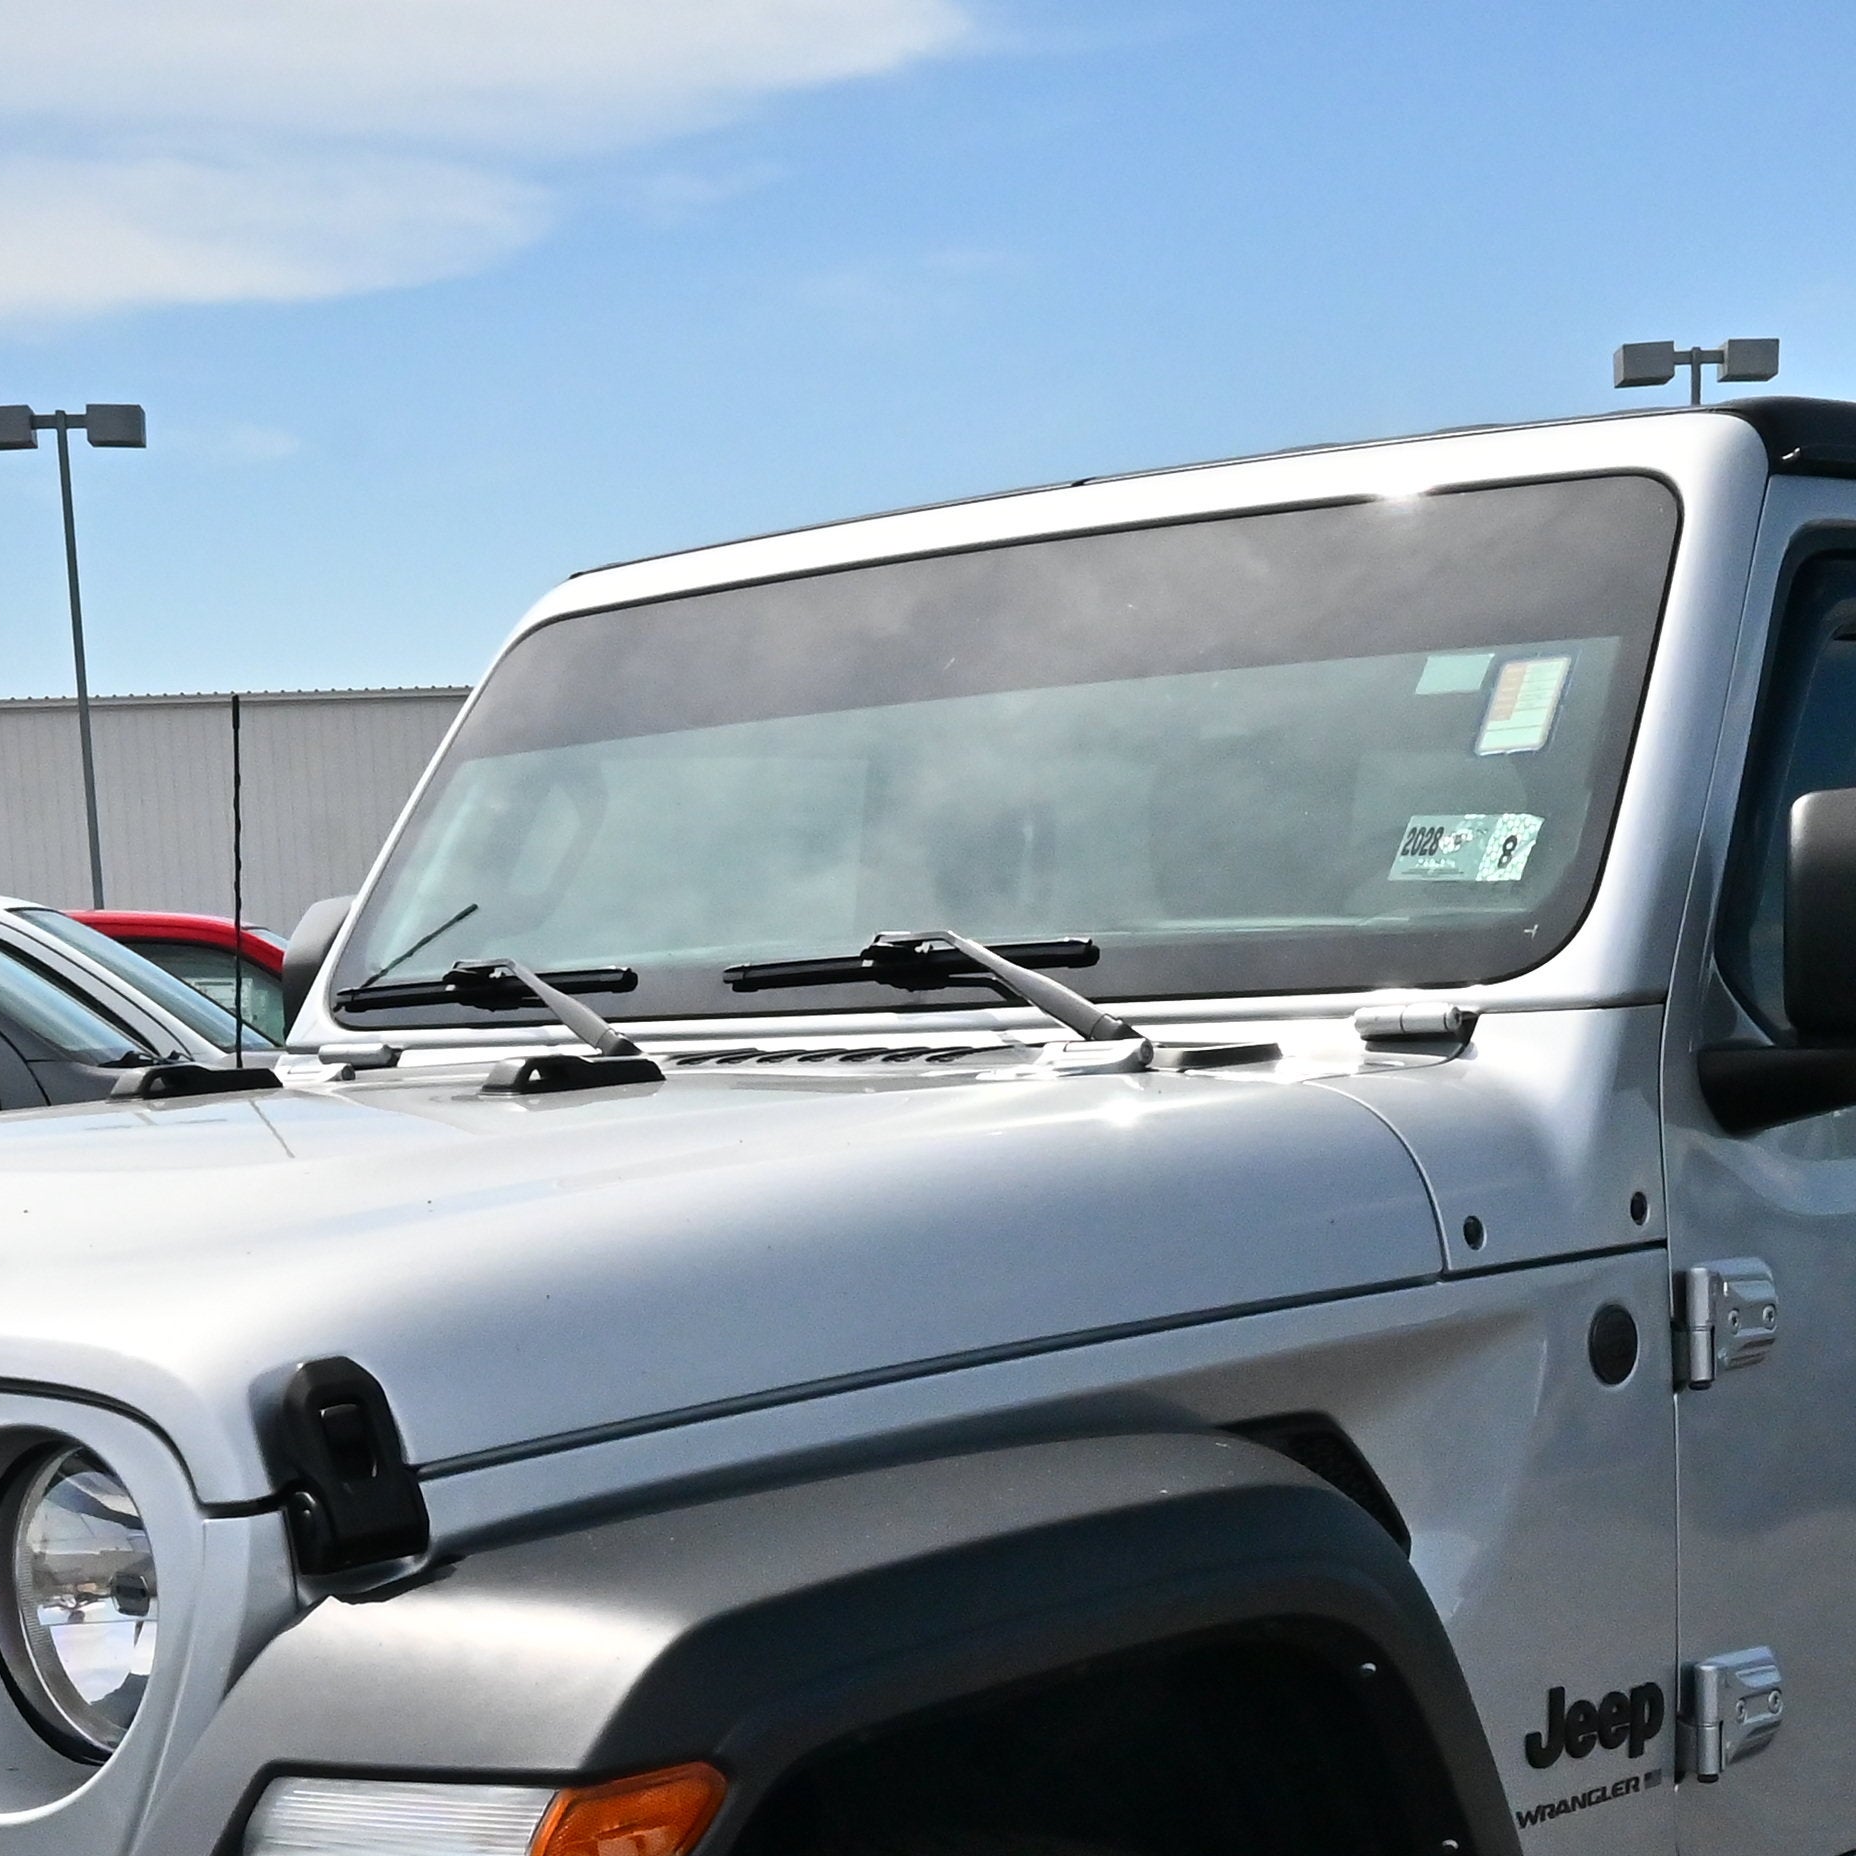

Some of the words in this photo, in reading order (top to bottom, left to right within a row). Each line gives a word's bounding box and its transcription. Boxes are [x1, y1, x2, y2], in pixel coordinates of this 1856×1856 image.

[1400, 826, 1445, 857] 2028
[1497, 834, 1518, 869] 8
[1524, 1681, 1665, 1769] Jeep
[1515, 1775, 1641, 1830] WRANGLER
